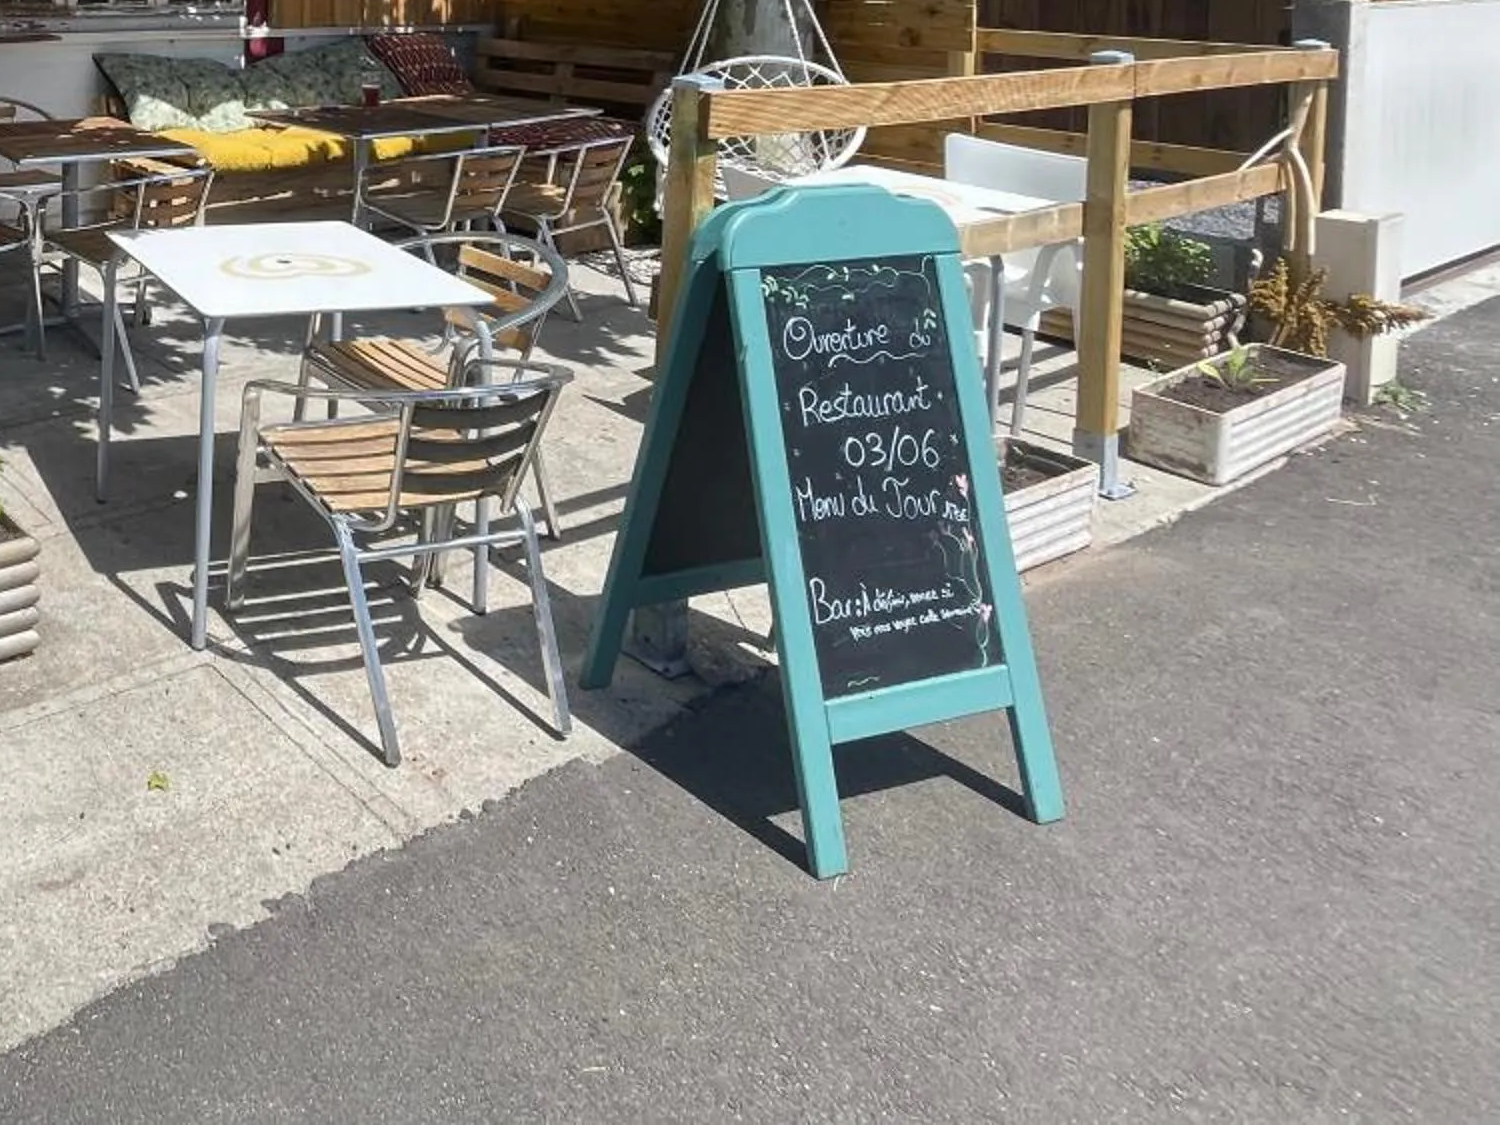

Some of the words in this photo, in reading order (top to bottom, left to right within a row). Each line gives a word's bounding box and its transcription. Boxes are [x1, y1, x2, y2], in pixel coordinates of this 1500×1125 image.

[783, 316, 890, 360] Ouverture
[909, 317, 931, 348] du
[799, 375, 932, 427] Restaurant
[844, 425, 940, 472] 03/06
[795, 476, 845, 522] Menu
[852, 475, 879, 516] du
[882, 476, 941, 519] Jour
